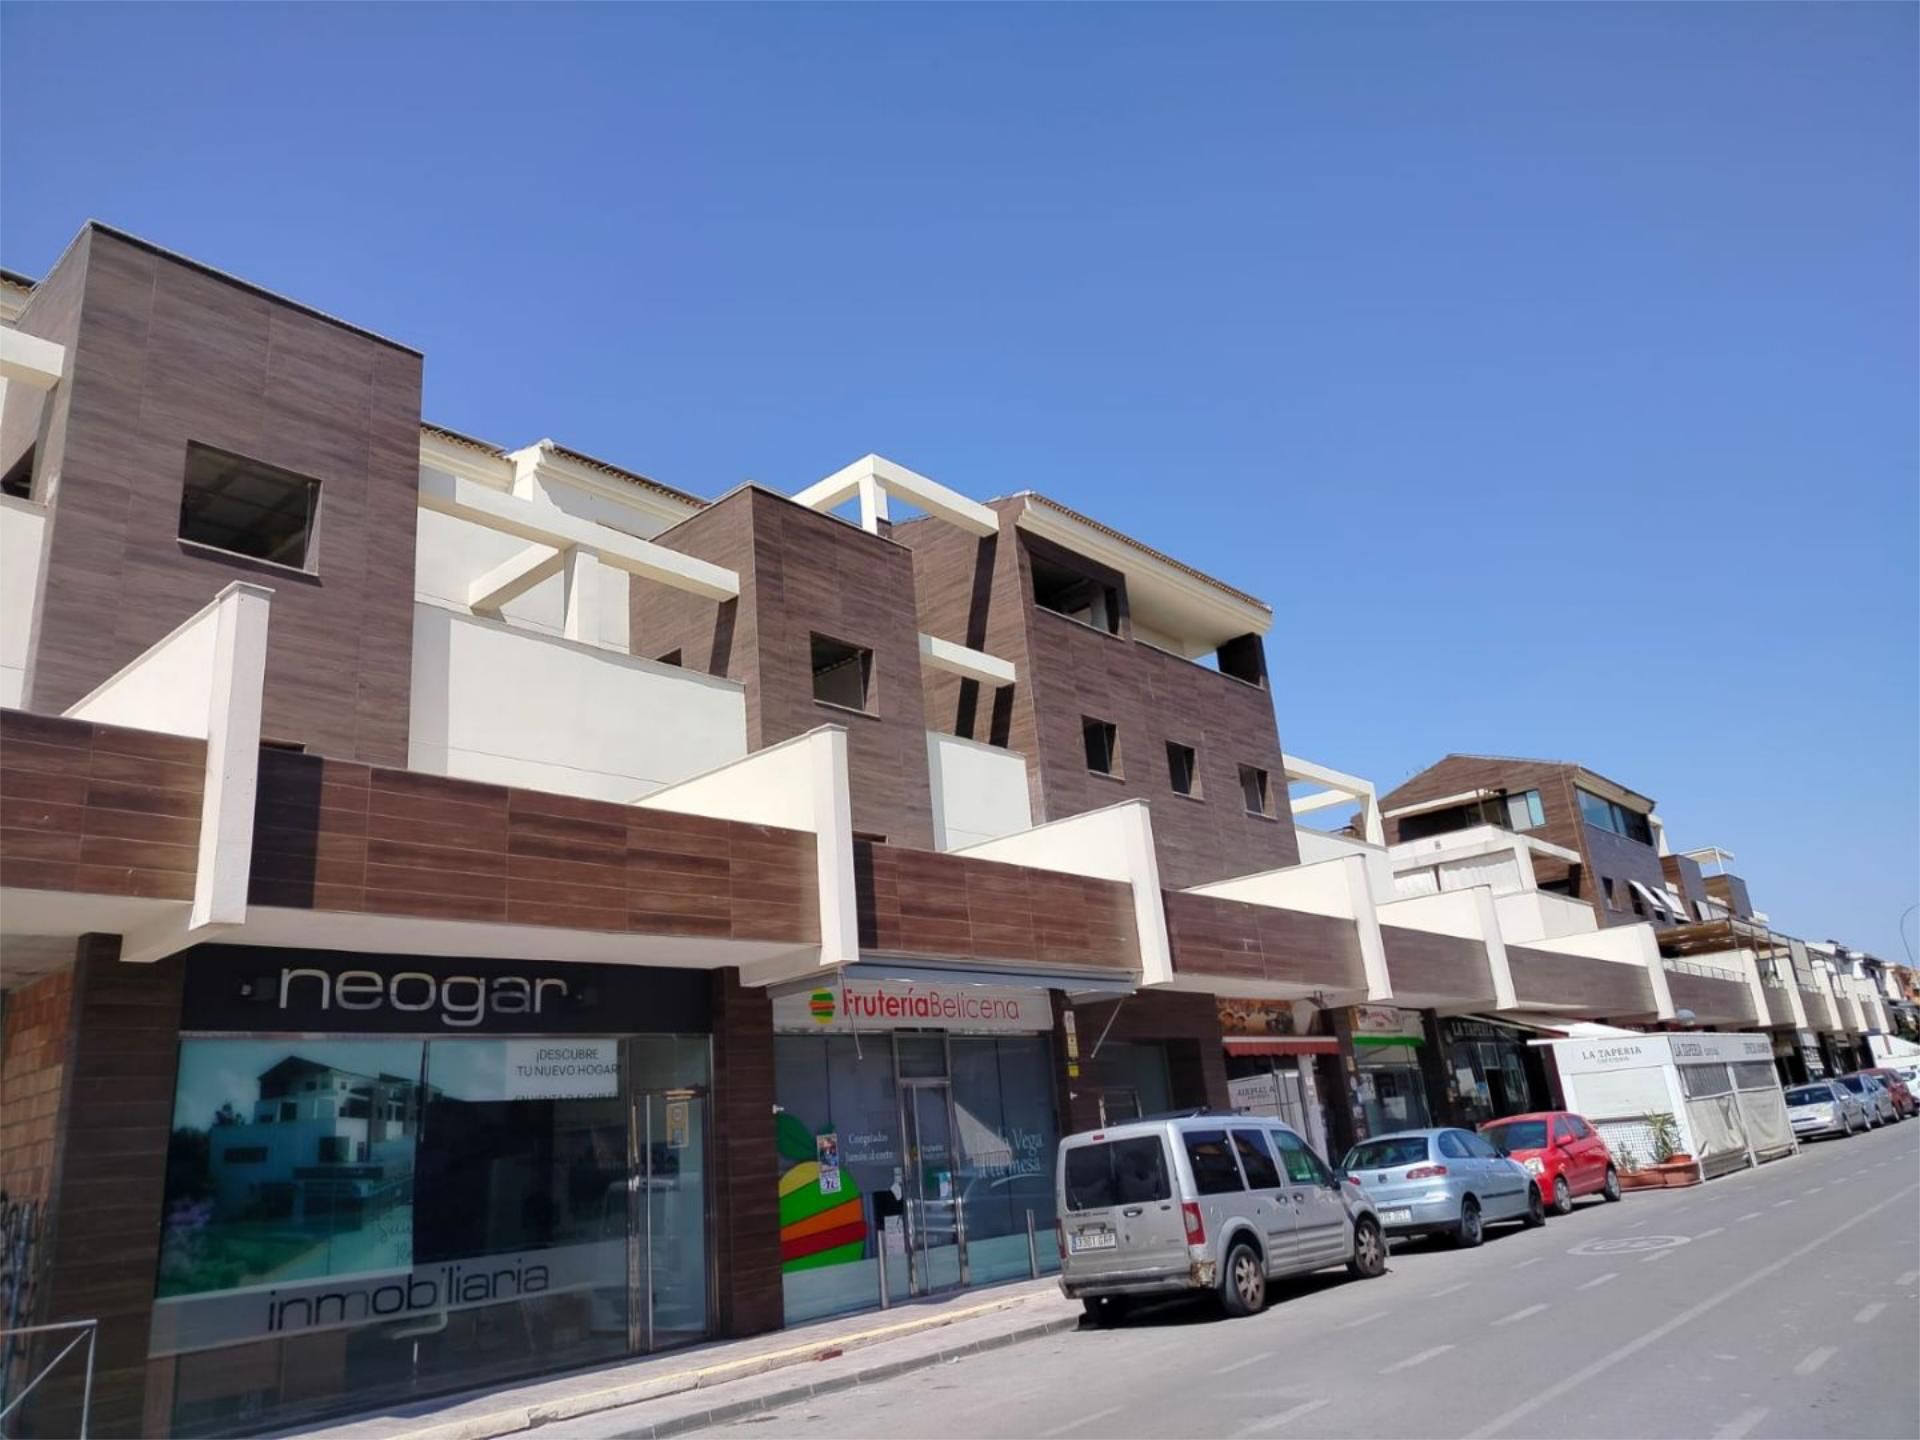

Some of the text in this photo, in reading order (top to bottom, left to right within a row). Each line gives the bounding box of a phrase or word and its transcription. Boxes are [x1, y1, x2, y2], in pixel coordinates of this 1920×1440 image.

[279, 967, 568, 1027] neogar
[536, 1047, 600, 1064] ¡DESCUBRE
[1582, 1050, 1596, 1060] LA
[516, 1064, 533, 1077] TU
[534, 1064, 576, 1077] NUEVO
[1012, 1127, 1045, 1157] Vega
[268, 1257, 550, 1339] inmobiliaria
